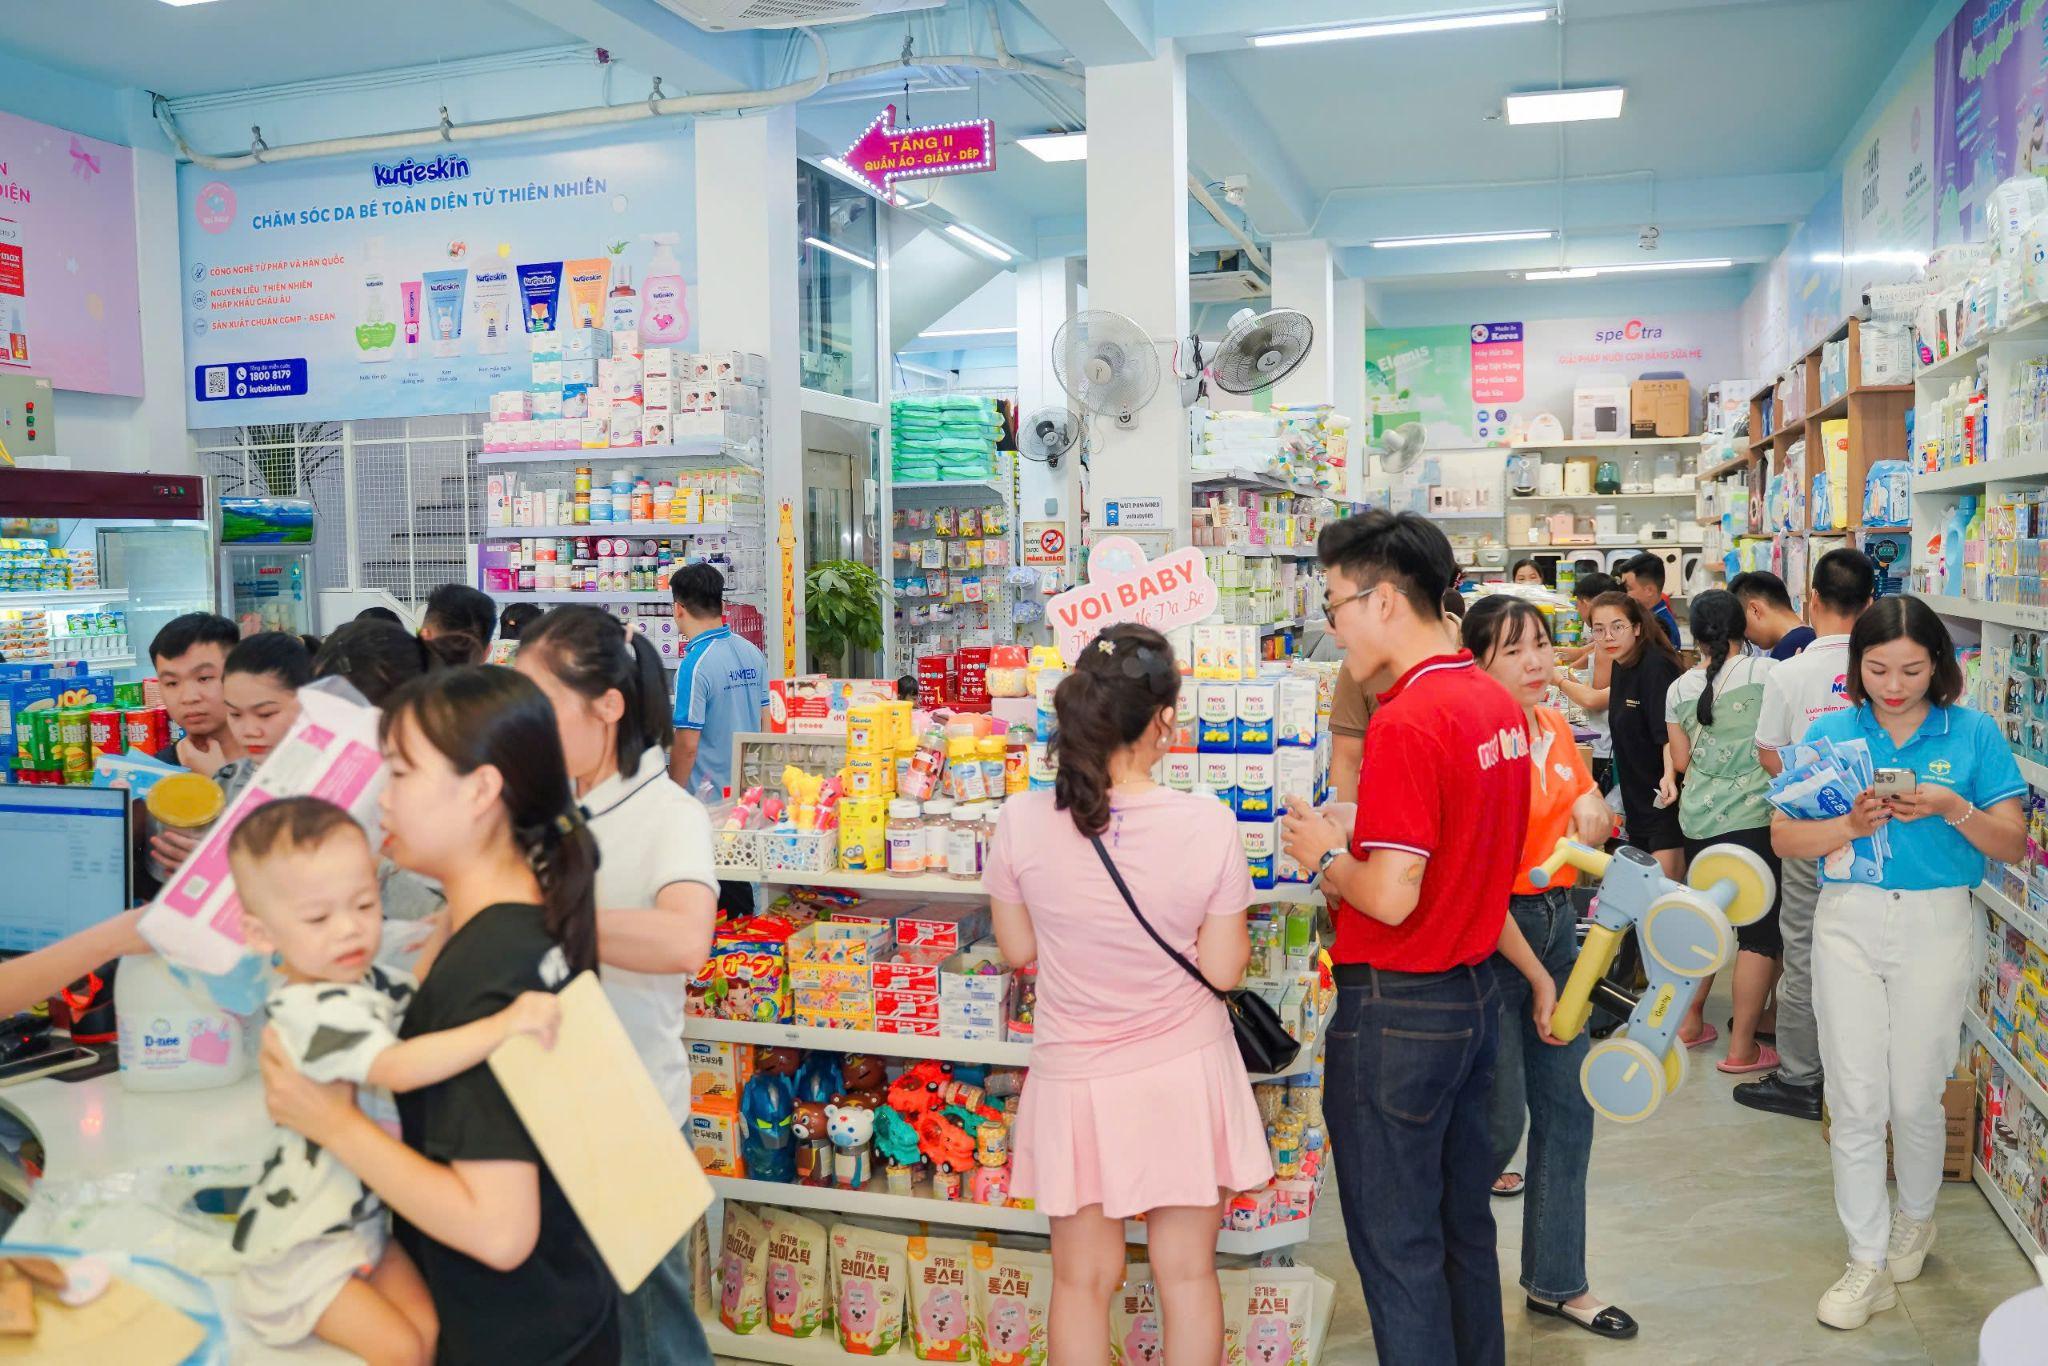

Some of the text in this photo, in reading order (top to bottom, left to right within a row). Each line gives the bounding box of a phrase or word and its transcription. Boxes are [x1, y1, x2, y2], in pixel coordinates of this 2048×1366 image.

[890, 134, 953, 154] TẦNG II
[864, 156, 896, 171] QUẦN
[899, 153, 915, 167] ÁO
[959, 147, 980, 161] DÉP
[252, 210, 296, 230] CHĂM
[300, 206, 330, 225] SÓC
[334, 205, 356, 222] DA
[359, 200, 378, 218] BÉ
[382, 193, 427, 216] TOÀN
[431, 191, 468, 213] DIỆN
[473, 186, 495, 205] TỪ
[499, 182, 549, 203] THIÊN
[553, 177, 608, 198] NHIÊN
[210, 264, 231, 276] CÔNG
[1491, 332, 1519, 341] Korea
[250, 370, 291, 381] 1800 8179
[1058, 560, 1192, 627] VOI BABY
[1207, 696, 1225, 704] neo
[1246, 696, 1263, 704] neo
[1171, 763, 1188, 771] neo
[1245, 764, 1263, 772] neo
[855, 1250, 876, 1263] 유기농
[934, 1257, 957, 1268] 유기농
[841, 1258, 890, 1282] 현미스틱
